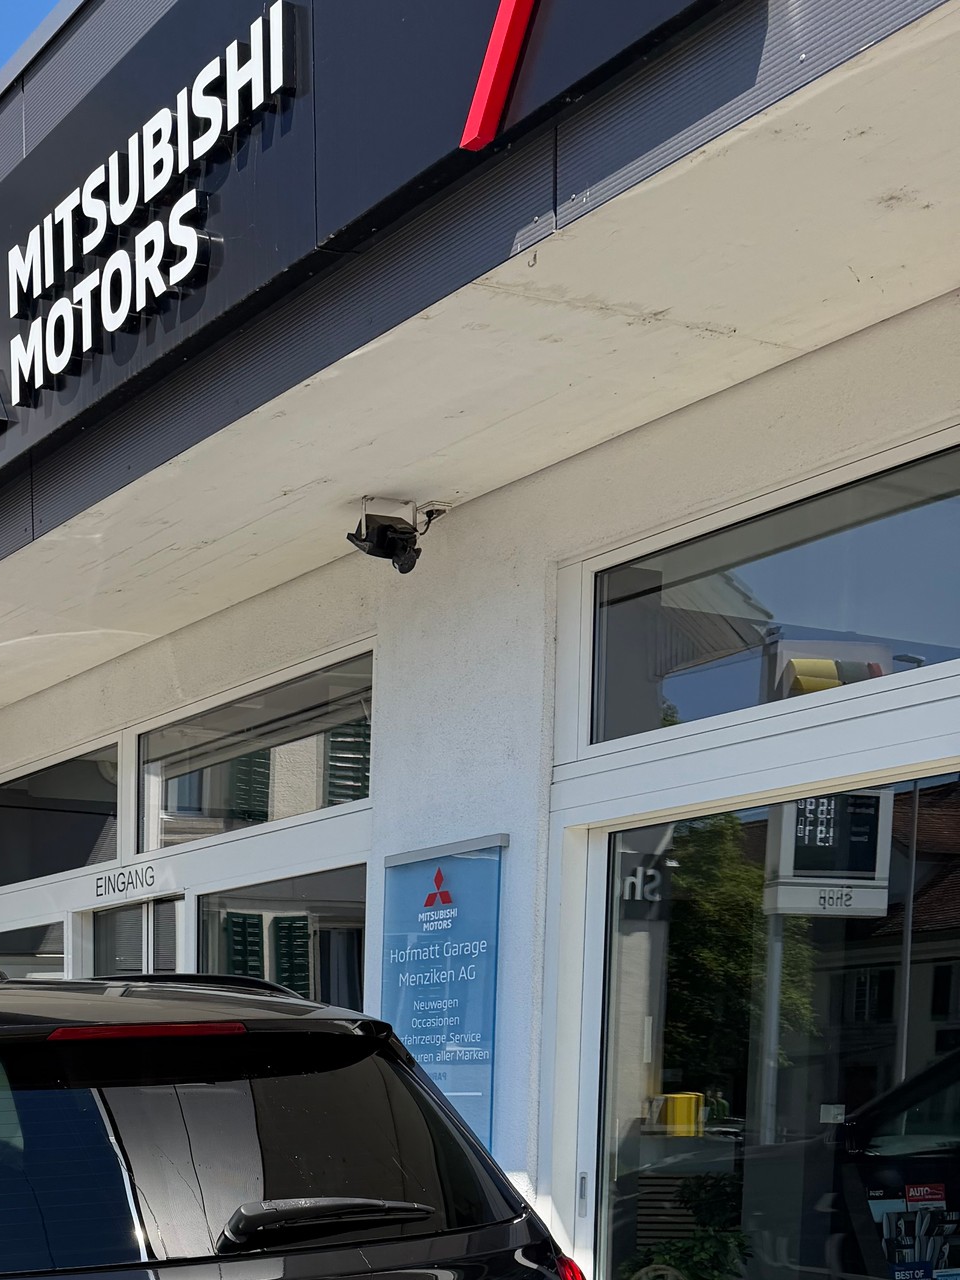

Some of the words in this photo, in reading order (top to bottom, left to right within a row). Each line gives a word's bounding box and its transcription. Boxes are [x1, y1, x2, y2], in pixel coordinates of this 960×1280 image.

[8, 0, 283, 318] MITSUBISHI
[9, 189, 197, 407] MOTORS
[96, 866, 155, 897] EINGANG
[418, 908, 458, 922] MITSUBISHI
[423, 919, 452, 931] MOTORS
[390, 943, 440, 963] Hofmatt
[443, 940, 488, 958] Garage
[399, 968, 455, 987] Menziken
[458, 965, 476, 981] AG
[413, 998, 459, 1012] Neuwagen
[411, 1016, 460, 1029] Occasionen
[400, 1033, 447, 1046] zfahrzeuge
[449, 1031, 482, 1044] Service
[436, 1050, 455, 1062] aller
[456, 1049, 490, 1061] Marken
[909, 1187, 930, 1196] AUTO
[895, 1271, 914, 1280] BEST
[914, 1270, 925, 1278] OF
